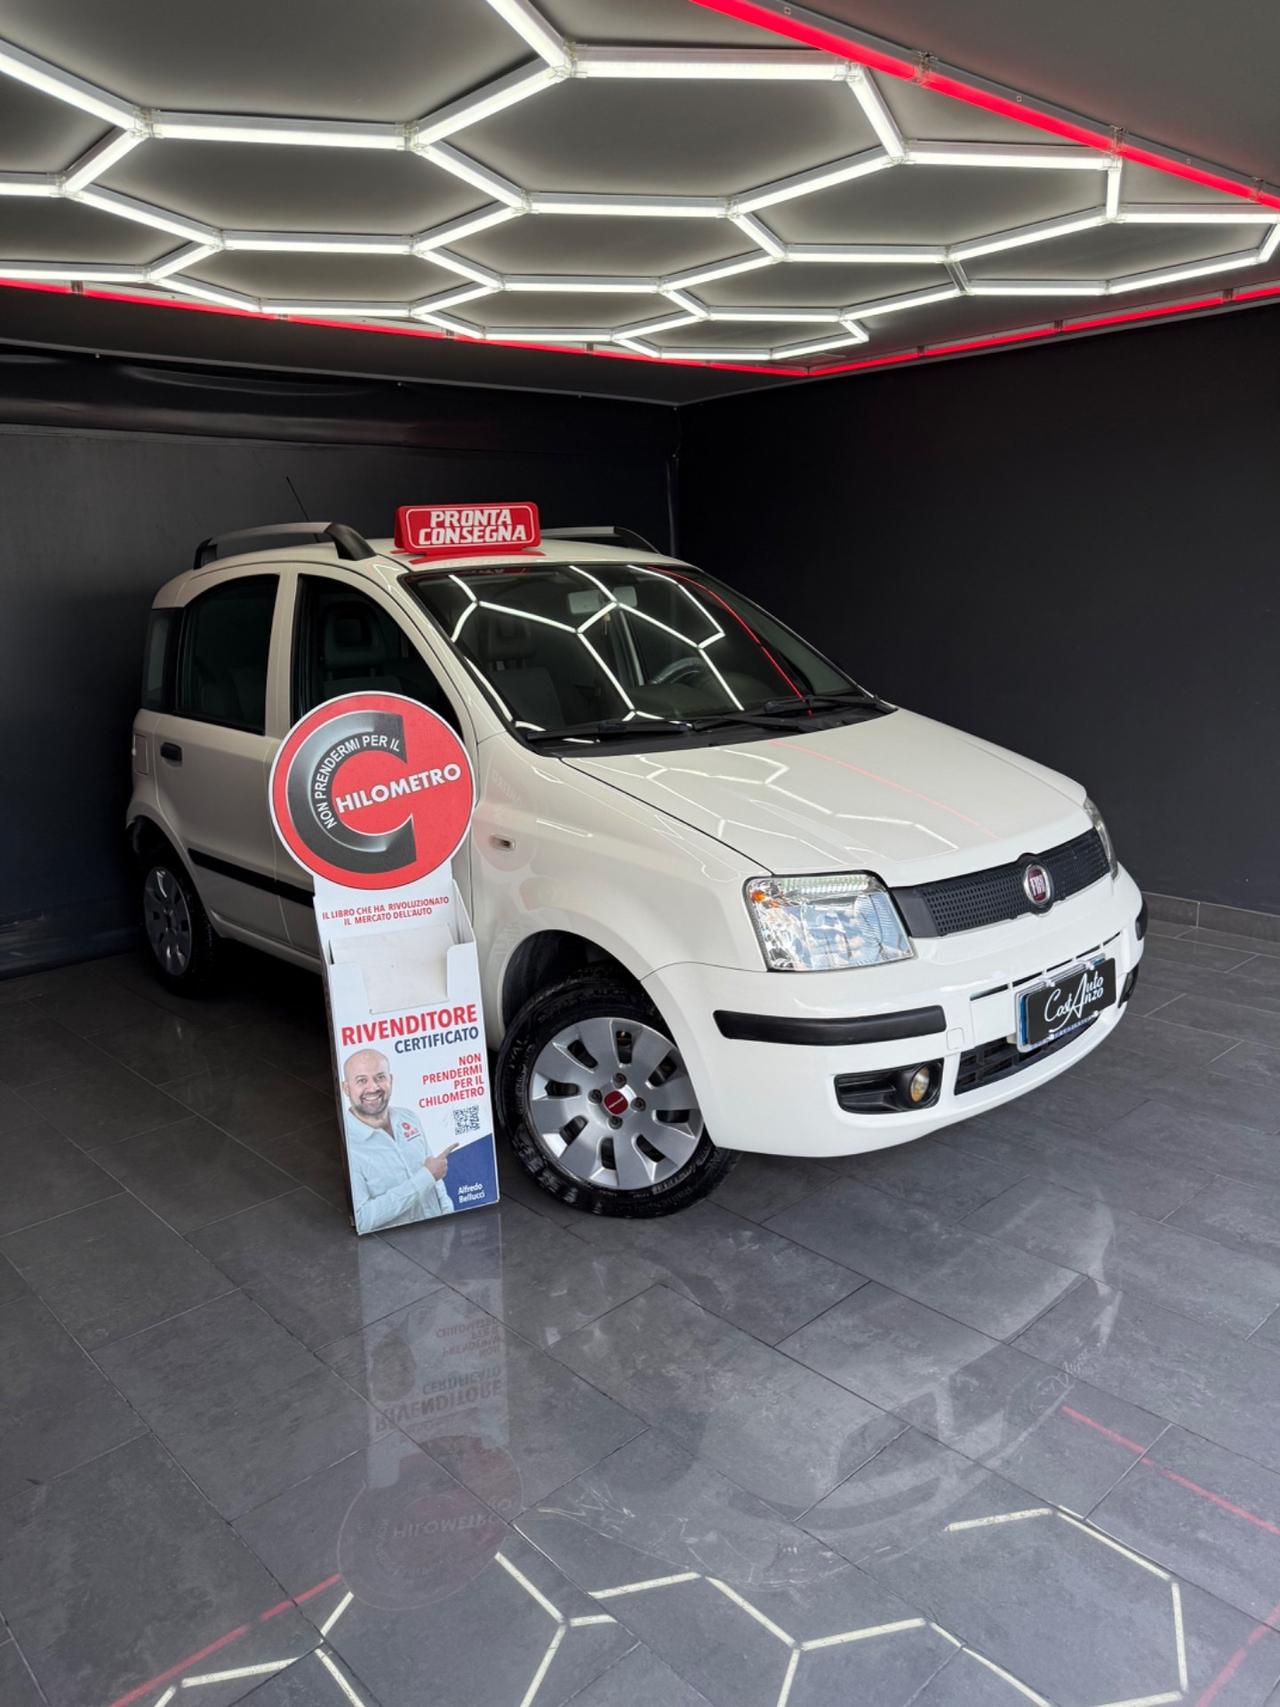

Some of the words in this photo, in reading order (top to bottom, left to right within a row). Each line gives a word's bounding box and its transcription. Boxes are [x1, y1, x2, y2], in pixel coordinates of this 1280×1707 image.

[430, 509, 512, 528] PRONTA
[418, 524, 527, 545] CONSEGNA
[362, 735, 388, 747] PER
[390, 738, 400, 752] IL
[314, 738, 360, 799] PRENDERMI
[316, 802, 337, 829] NON
[322, 912, 330, 920] IL
[331, 908, 355, 918] LIBRO
[356, 905, 372, 915] CHE
[373, 904, 385, 913] HA
[388, 896, 449, 911] RIVOLUZIONATO
[343, 918, 351, 926] IL
[354, 912, 392, 924] MERCATO
[393, 907, 433, 920] DELL'AUTO
[341, 1004, 478, 1046] RIVENDITORE
[394, 1026, 479, 1054] CERTIFICATO
[458, 1053, 482, 1067] NON
[422, 1064, 483, 1085] PRENDERMI
[453, 1078, 473, 1090] PER
[475, 1075, 484, 1086] IL
[418, 1086, 485, 1108] CHILOMETRO
[458, 1182, 483, 1195] Alfredo
[459, 1190, 485, 1203] Bellucci
